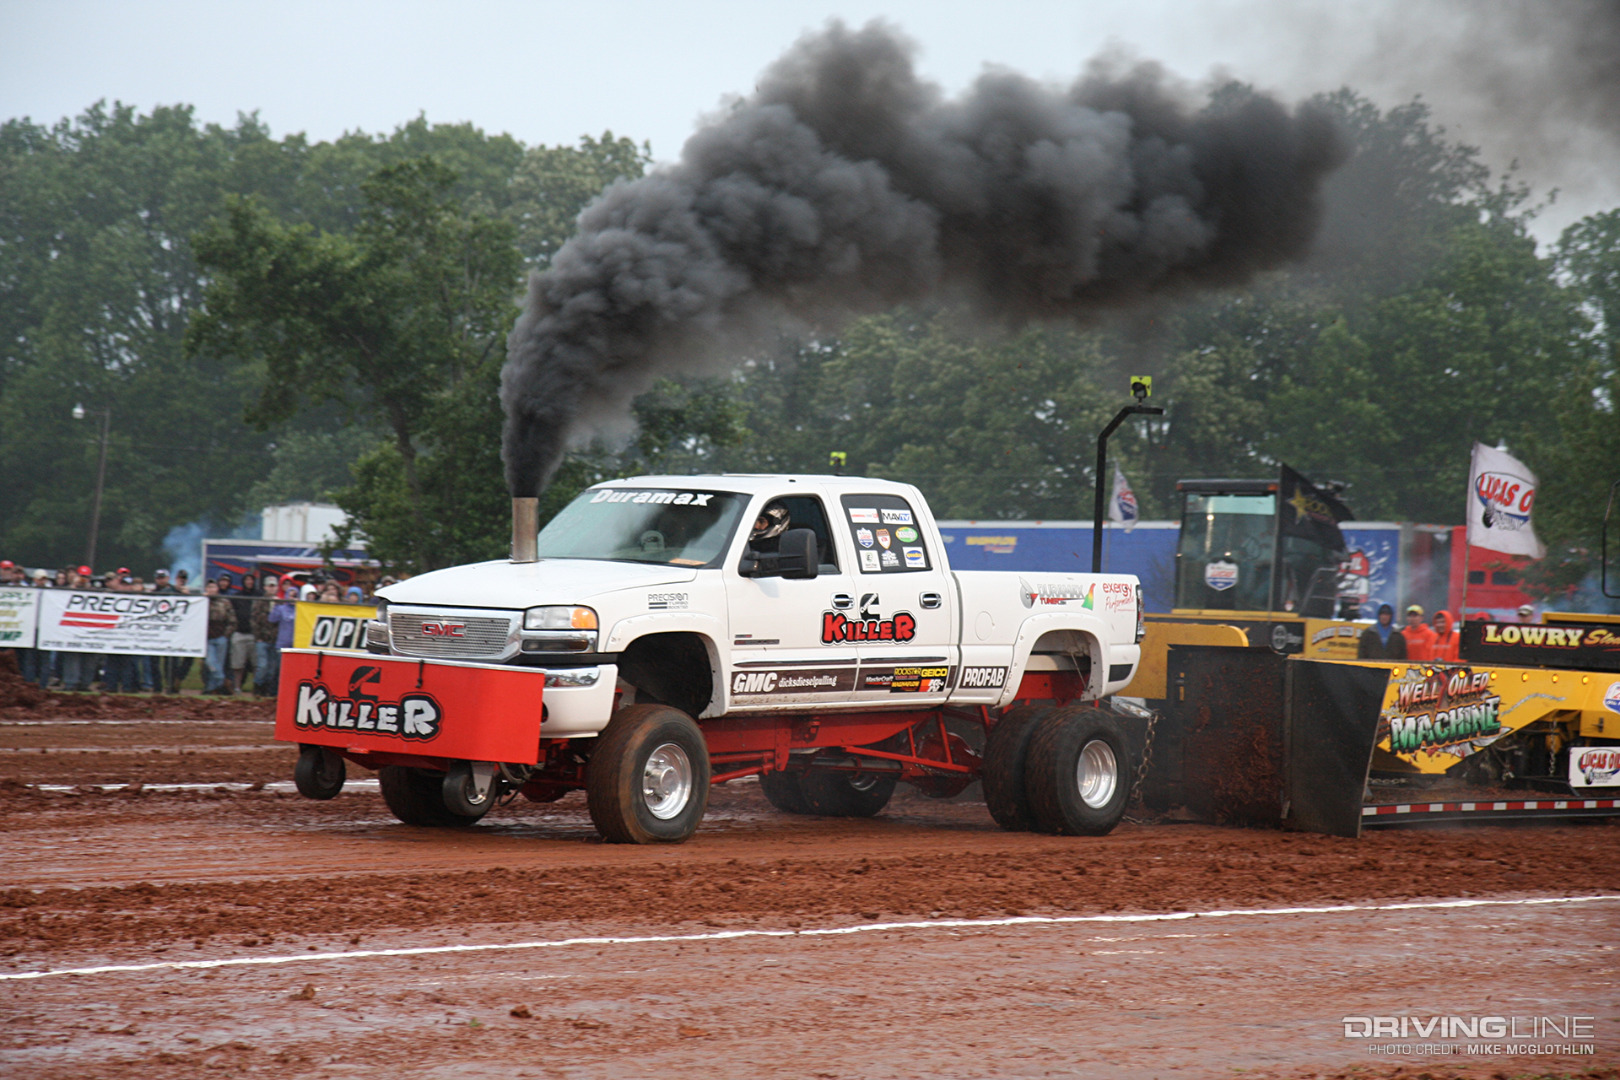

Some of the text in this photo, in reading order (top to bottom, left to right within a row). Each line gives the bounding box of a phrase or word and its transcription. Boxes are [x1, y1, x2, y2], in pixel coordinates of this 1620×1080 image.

[589, 489, 715, 507] Duramax
[1478, 472, 1521, 507] LUCAS
[648, 592, 689, 601] PRECISION
[1102, 582, 1133, 597] exergy
[66, 594, 190, 615] PRECISION
[421, 622, 465, 638] GMC
[822, 612, 916, 643] KILLER
[1485, 624, 1584, 647] LOWRY
[733, 671, 778, 693] GMC
[921, 668, 948, 677] GEICO
[962, 667, 1004, 688] PROFAB
[1399, 672, 1490, 706] WELL OILED
[296, 685, 438, 736] KILLER
[1391, 696, 1502, 750] MACHINE
[1580, 753, 1608, 769] LUCAS
